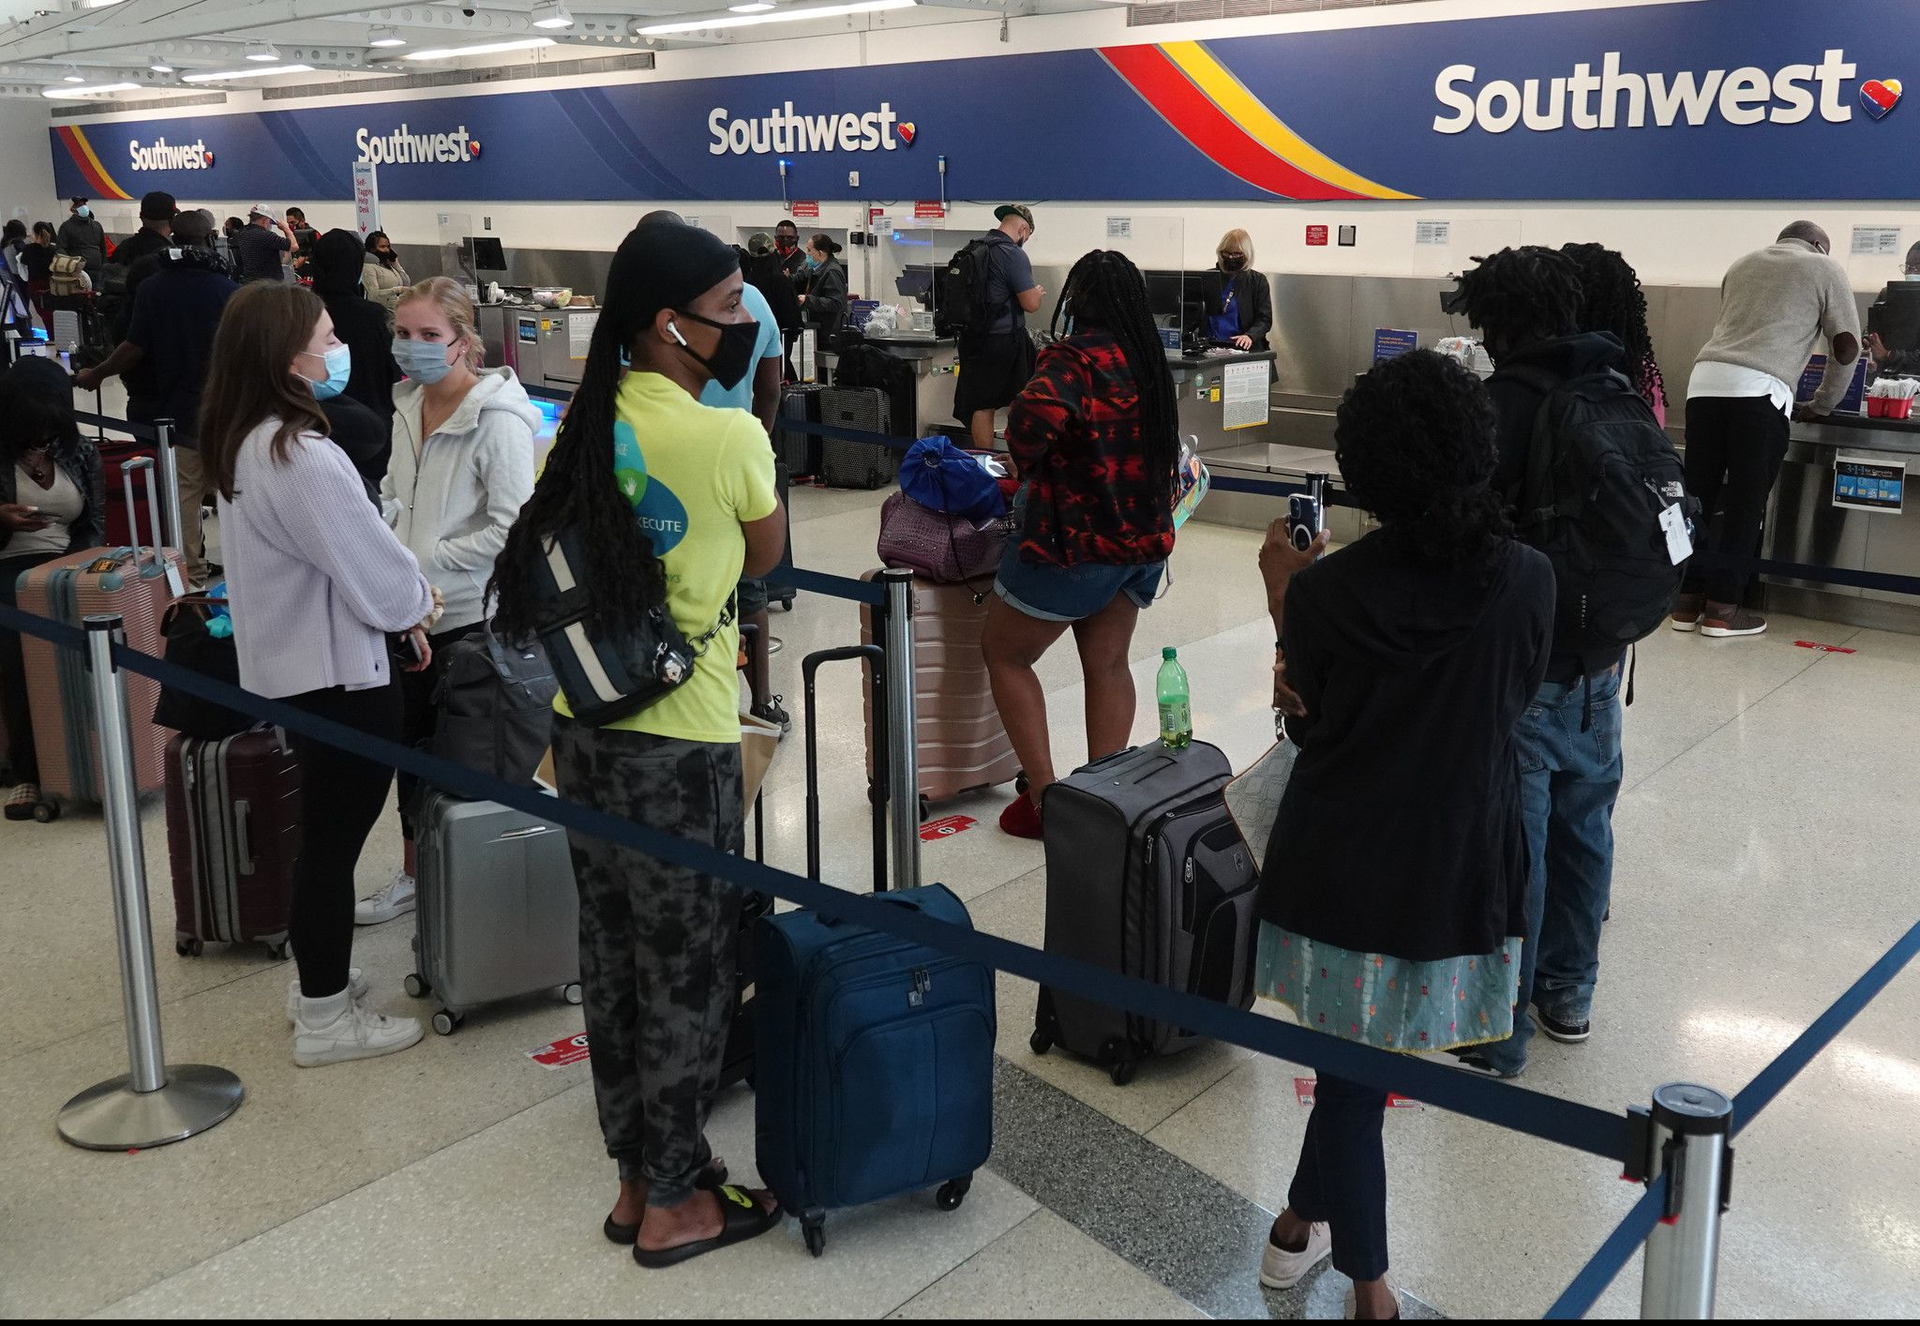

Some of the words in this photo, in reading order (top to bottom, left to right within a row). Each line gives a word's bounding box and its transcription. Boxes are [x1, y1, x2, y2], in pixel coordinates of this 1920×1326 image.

[1433, 49, 1857, 133] Southwest
[356, 123, 471, 165] Southwest
[708, 101, 897, 155] Southwest
[129, 137, 208, 171] Southwest
[637, 516, 682, 533] XECUTE
